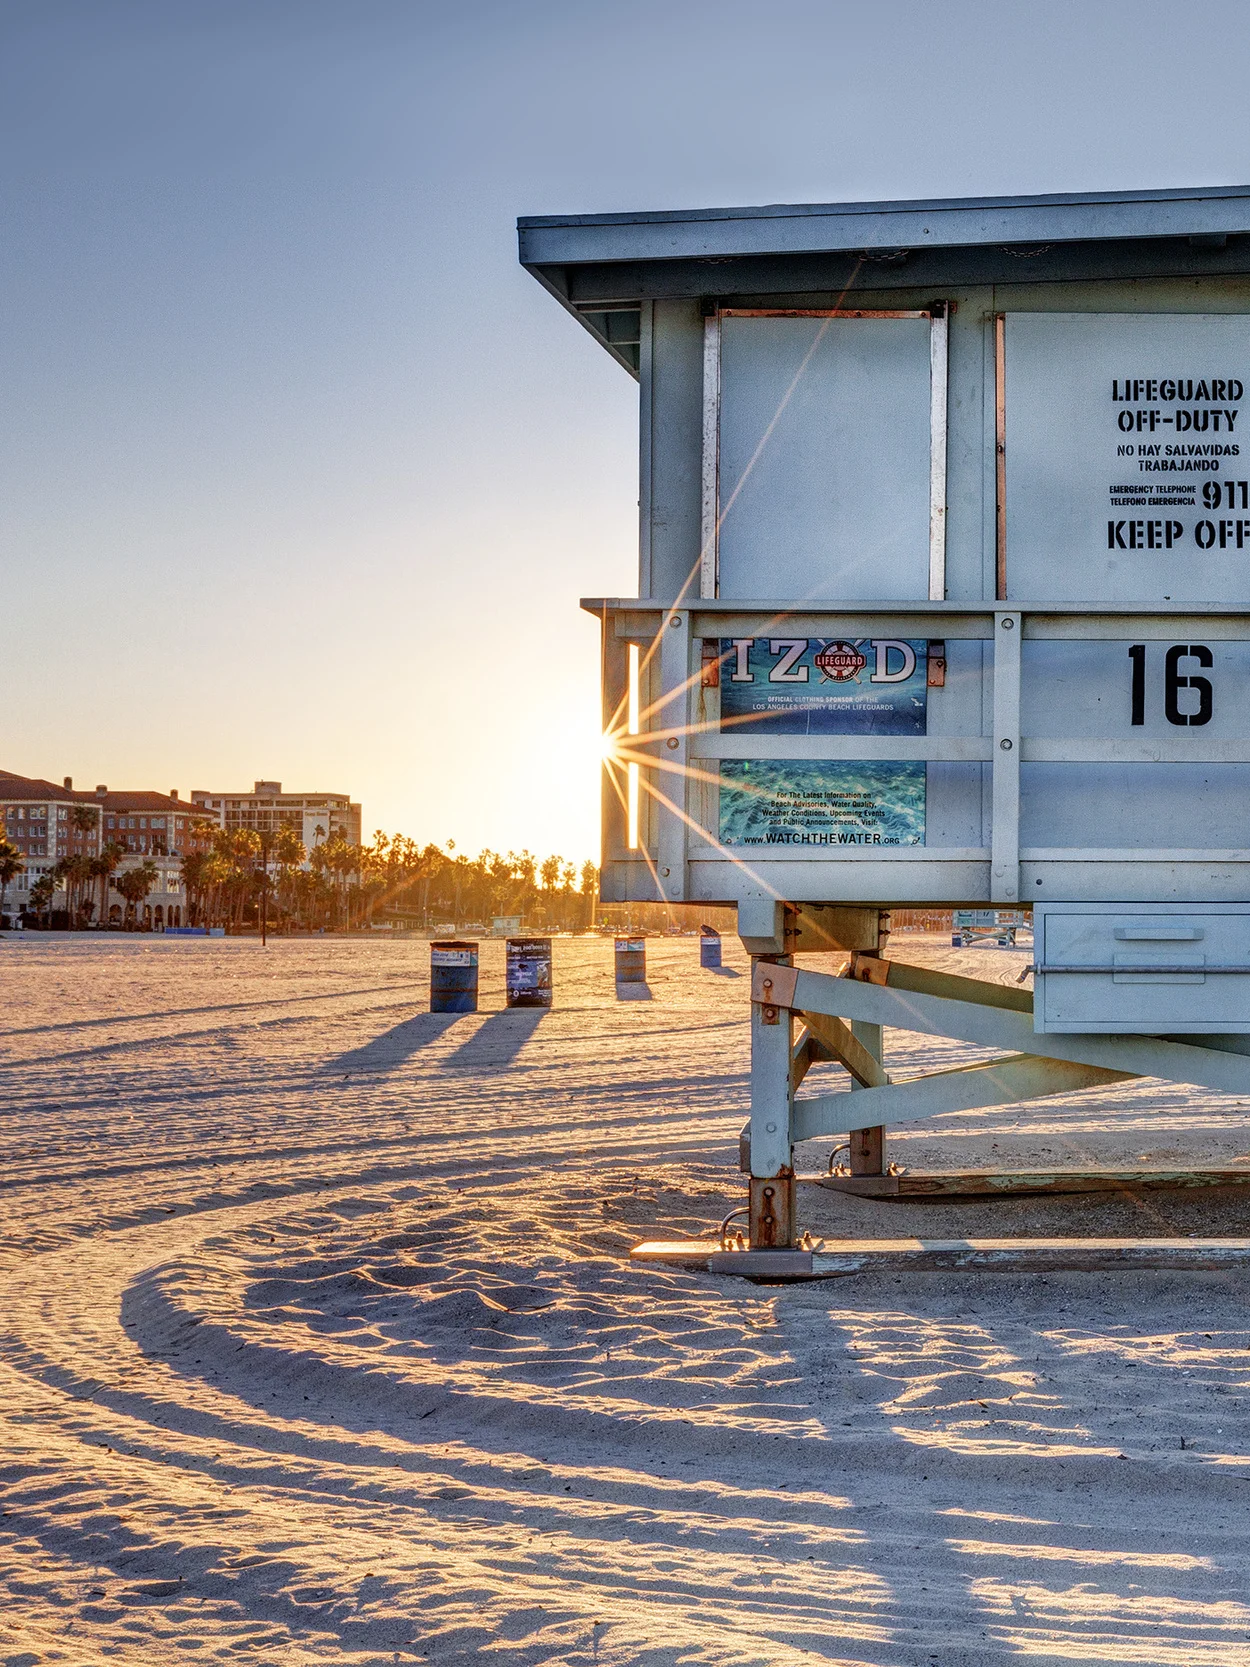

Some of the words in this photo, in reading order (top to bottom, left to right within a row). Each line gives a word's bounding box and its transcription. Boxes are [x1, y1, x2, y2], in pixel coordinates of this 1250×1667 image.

[1112, 379, 1244, 402] LIFEGUARD
[1117, 409, 1239, 433] OFF-DUTY
[1117, 444, 1135, 457] NO
[1138, 444, 1162, 457] HAY
[1164, 444, 1240, 457] SALVAVIDAS
[1138, 459, 1220, 472] TRABAJANDO
[1109, 485, 1154, 495] EMERGENCY
[1155, 485, 1197, 494] TELEPHONE
[1202, 480, 1249, 510] 911
[1110, 497, 1147, 507] TELEFONO
[1147, 496, 1196, 506] EMERGENCIA
[1107, 520, 1184, 550] KEEP
[1194, 519, 1250, 550] OFF
[816, 656, 863, 665] LIFEGUARD
[1128, 644, 1214, 726] 16
[752, 703, 766, 711] LOS
[767, 703, 798, 711] ANGELES
[799, 703, 826, 711] COUNTY
[828, 703, 851, 711] BEACH
[852, 703, 894, 711] LIFEGUARDS
